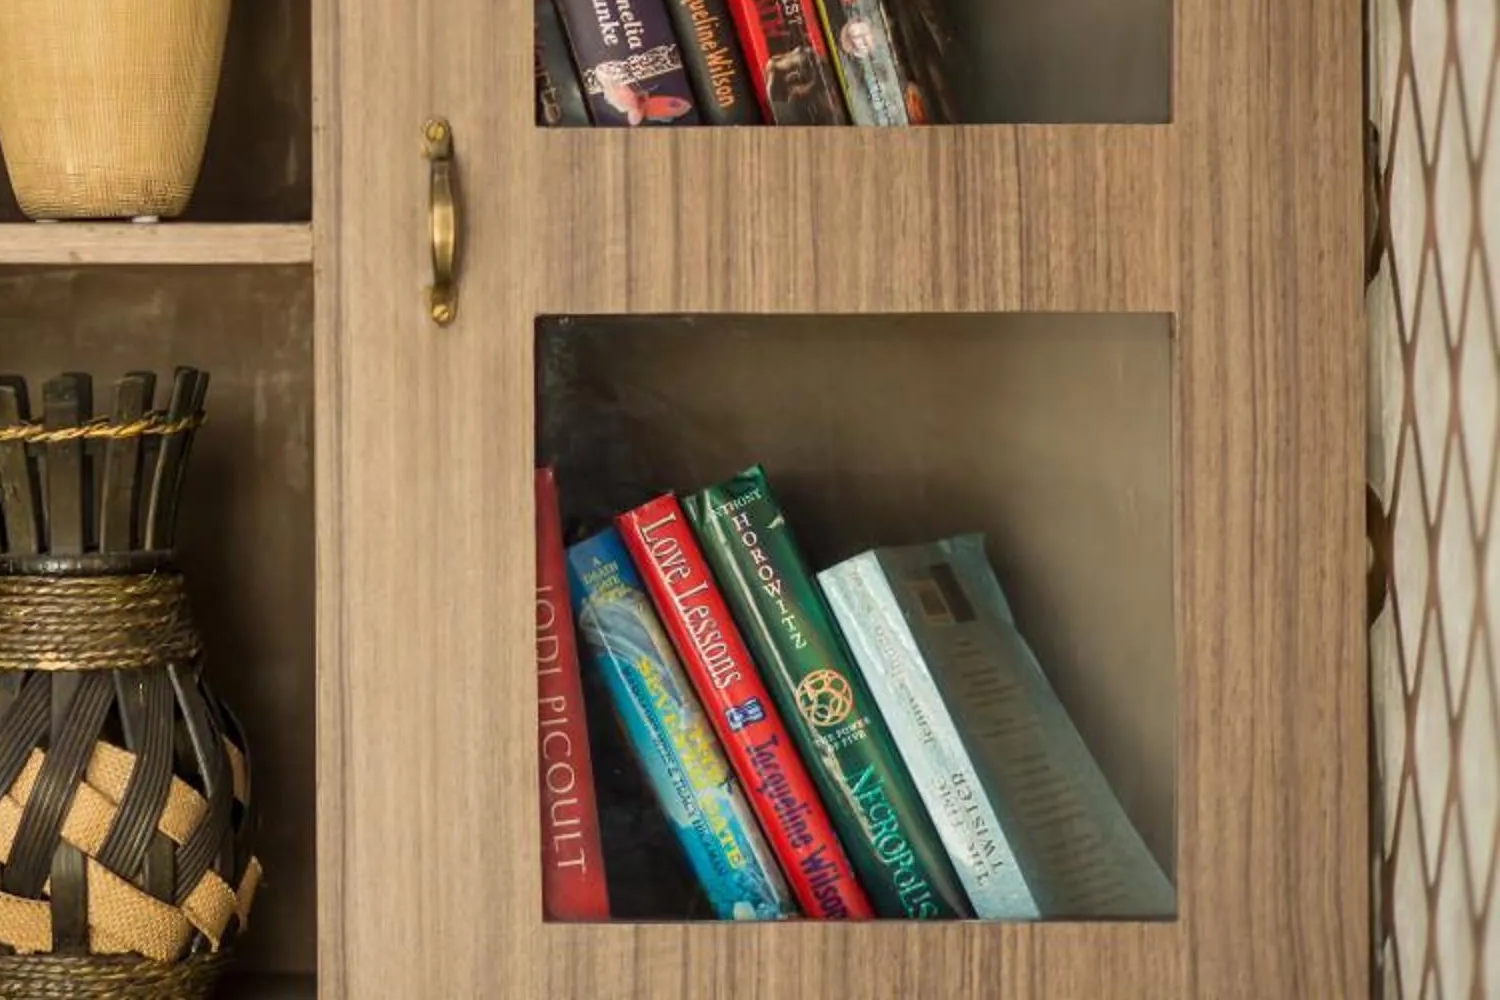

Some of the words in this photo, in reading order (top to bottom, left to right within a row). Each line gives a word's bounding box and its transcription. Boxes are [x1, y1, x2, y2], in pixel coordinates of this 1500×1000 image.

[706, 44, 737, 108] Wilson
[713, 488, 763, 518] NTHONY
[731, 513, 808, 649] HOROWITZ
[642, 511, 691, 585] Love
[676, 580, 741, 690] Lessons
[538, 695, 587, 874] PICOULT
[746, 732, 814, 850] Jacqueline
[802, 844, 847, 919] Wilson
[843, 763, 938, 919] NECROPOLIS
